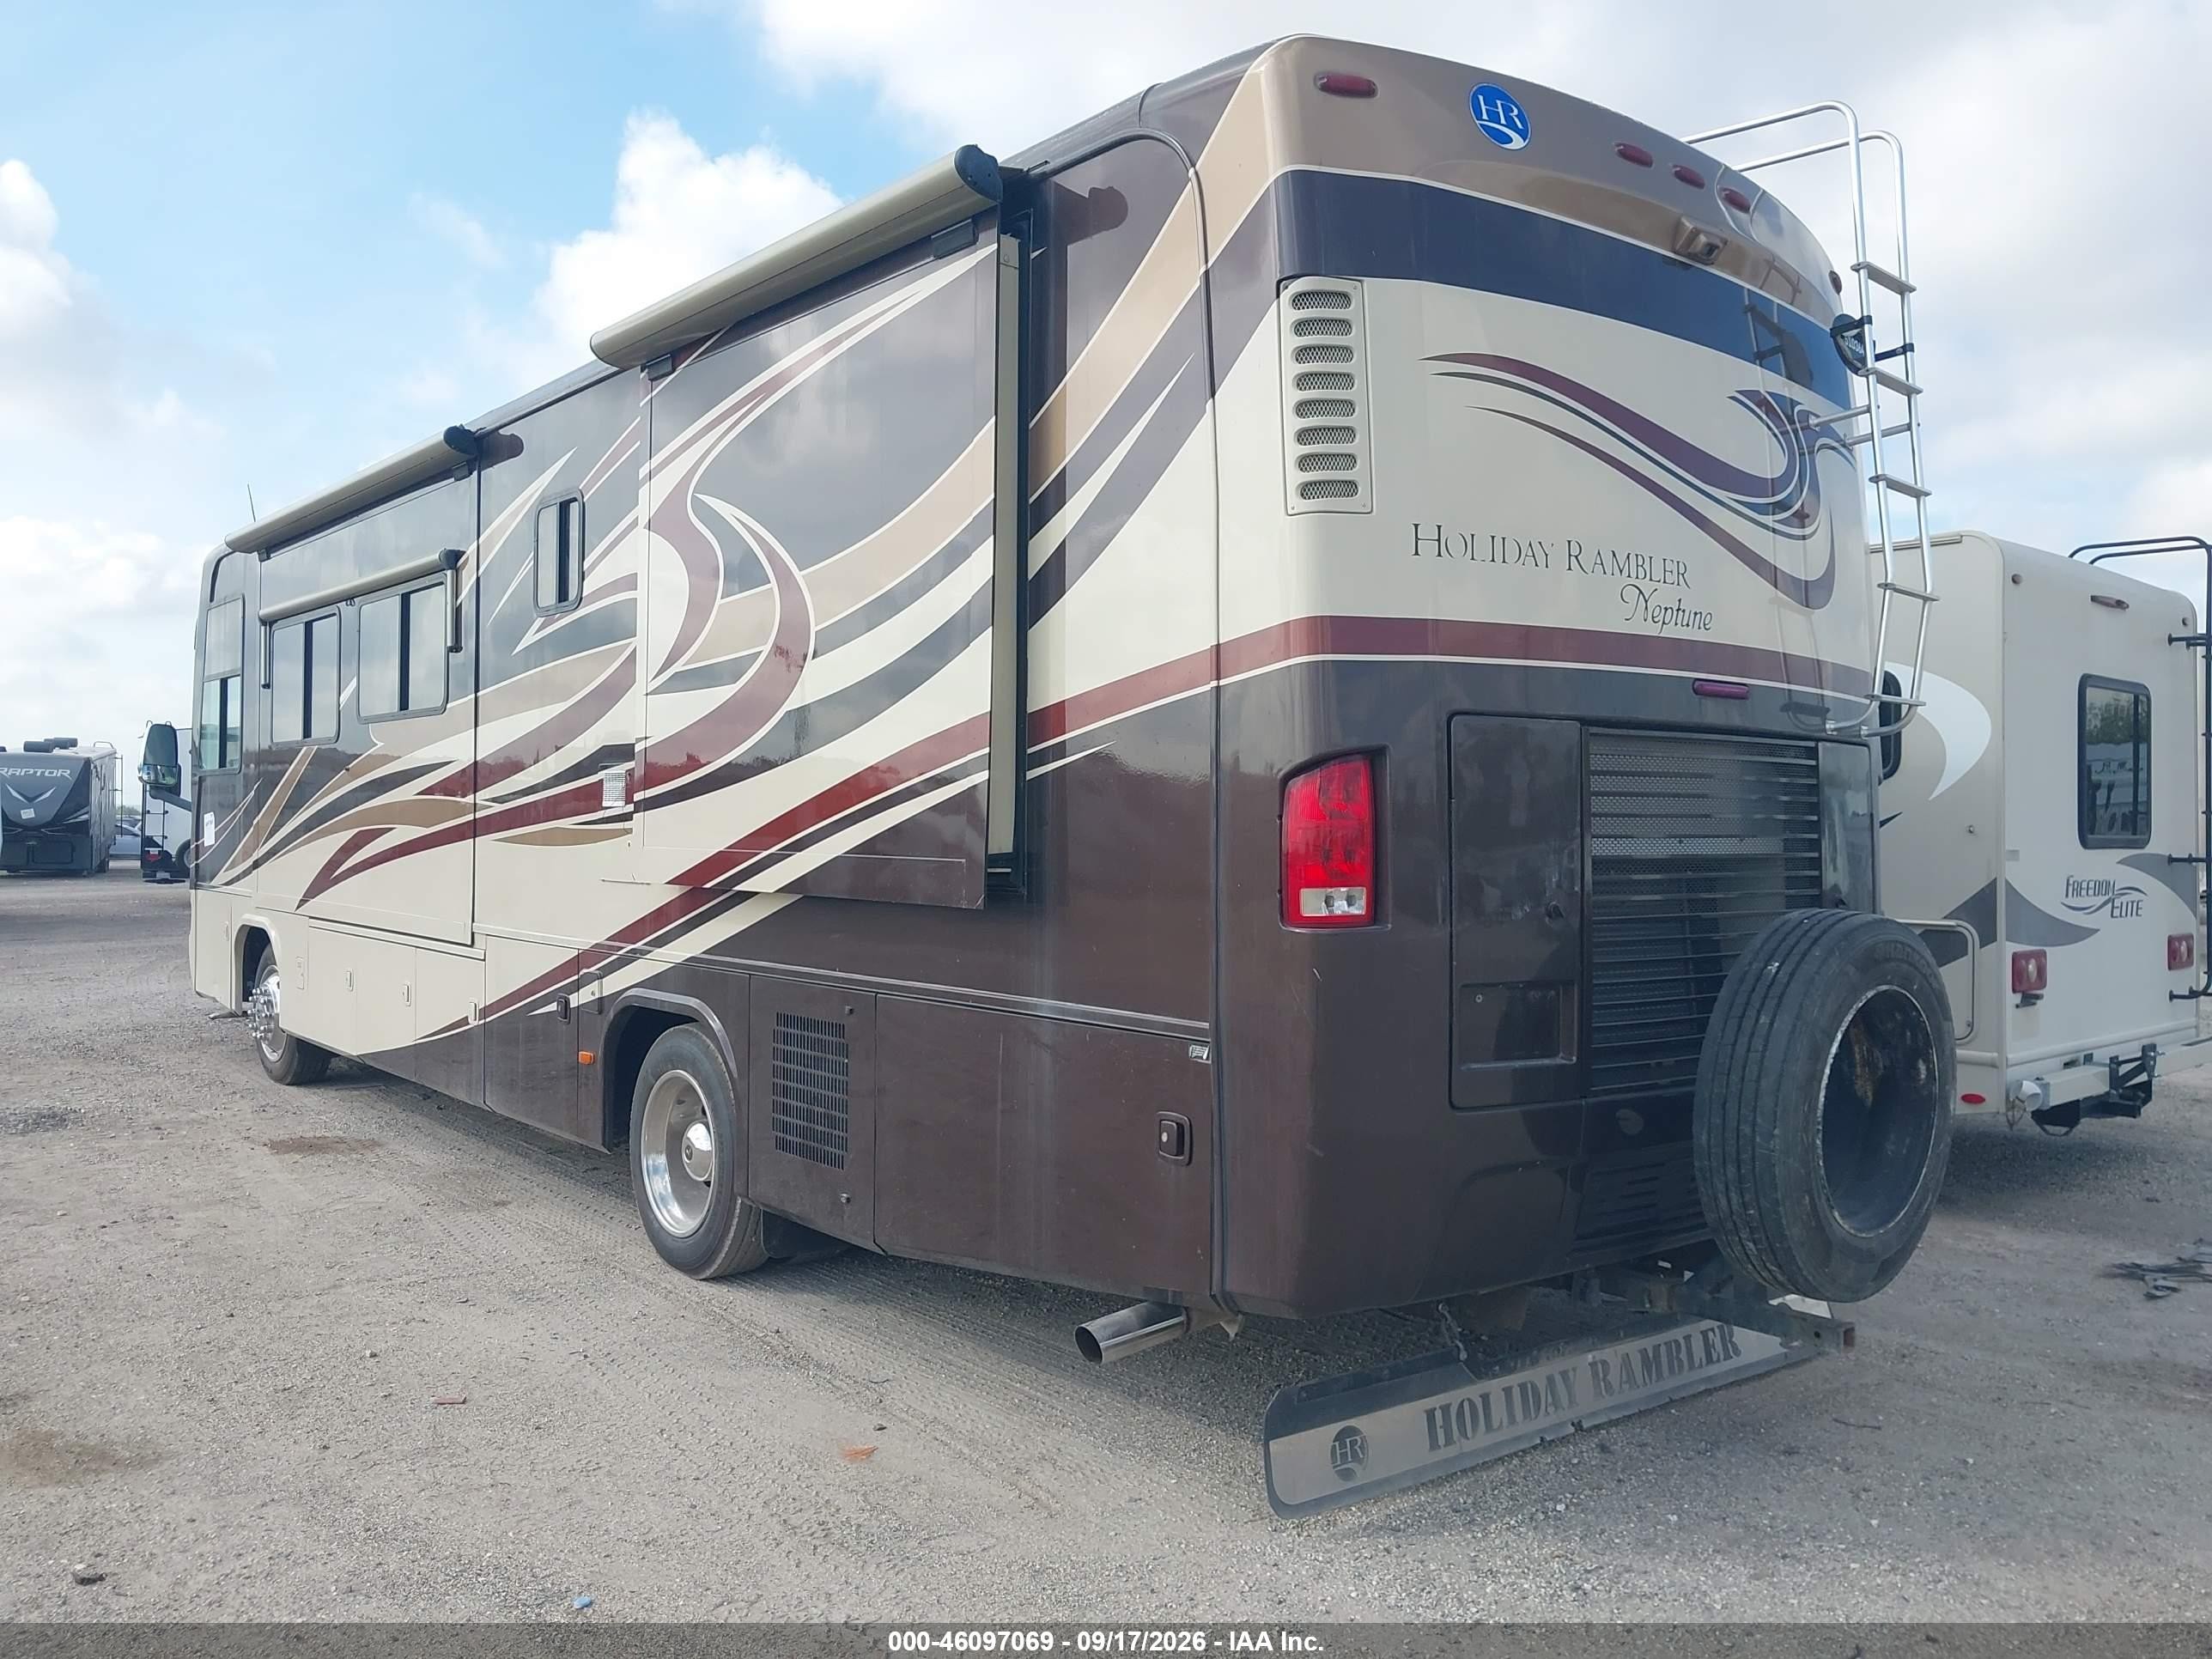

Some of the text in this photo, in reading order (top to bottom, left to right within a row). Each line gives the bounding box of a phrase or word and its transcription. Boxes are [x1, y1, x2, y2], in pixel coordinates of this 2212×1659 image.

[1477, 94, 1524, 130] HR
[1412, 522, 1691, 590] HOLIDAY RAMBLER
[1620, 582, 1713, 635] Neptune
[2065, 874, 2116, 899] FREEDOM
[2111, 896, 2144, 919] ELITE
[1425, 1317, 1742, 1452] HOLIDAY RAMBLER
[1332, 1435, 1367, 1465] HR
